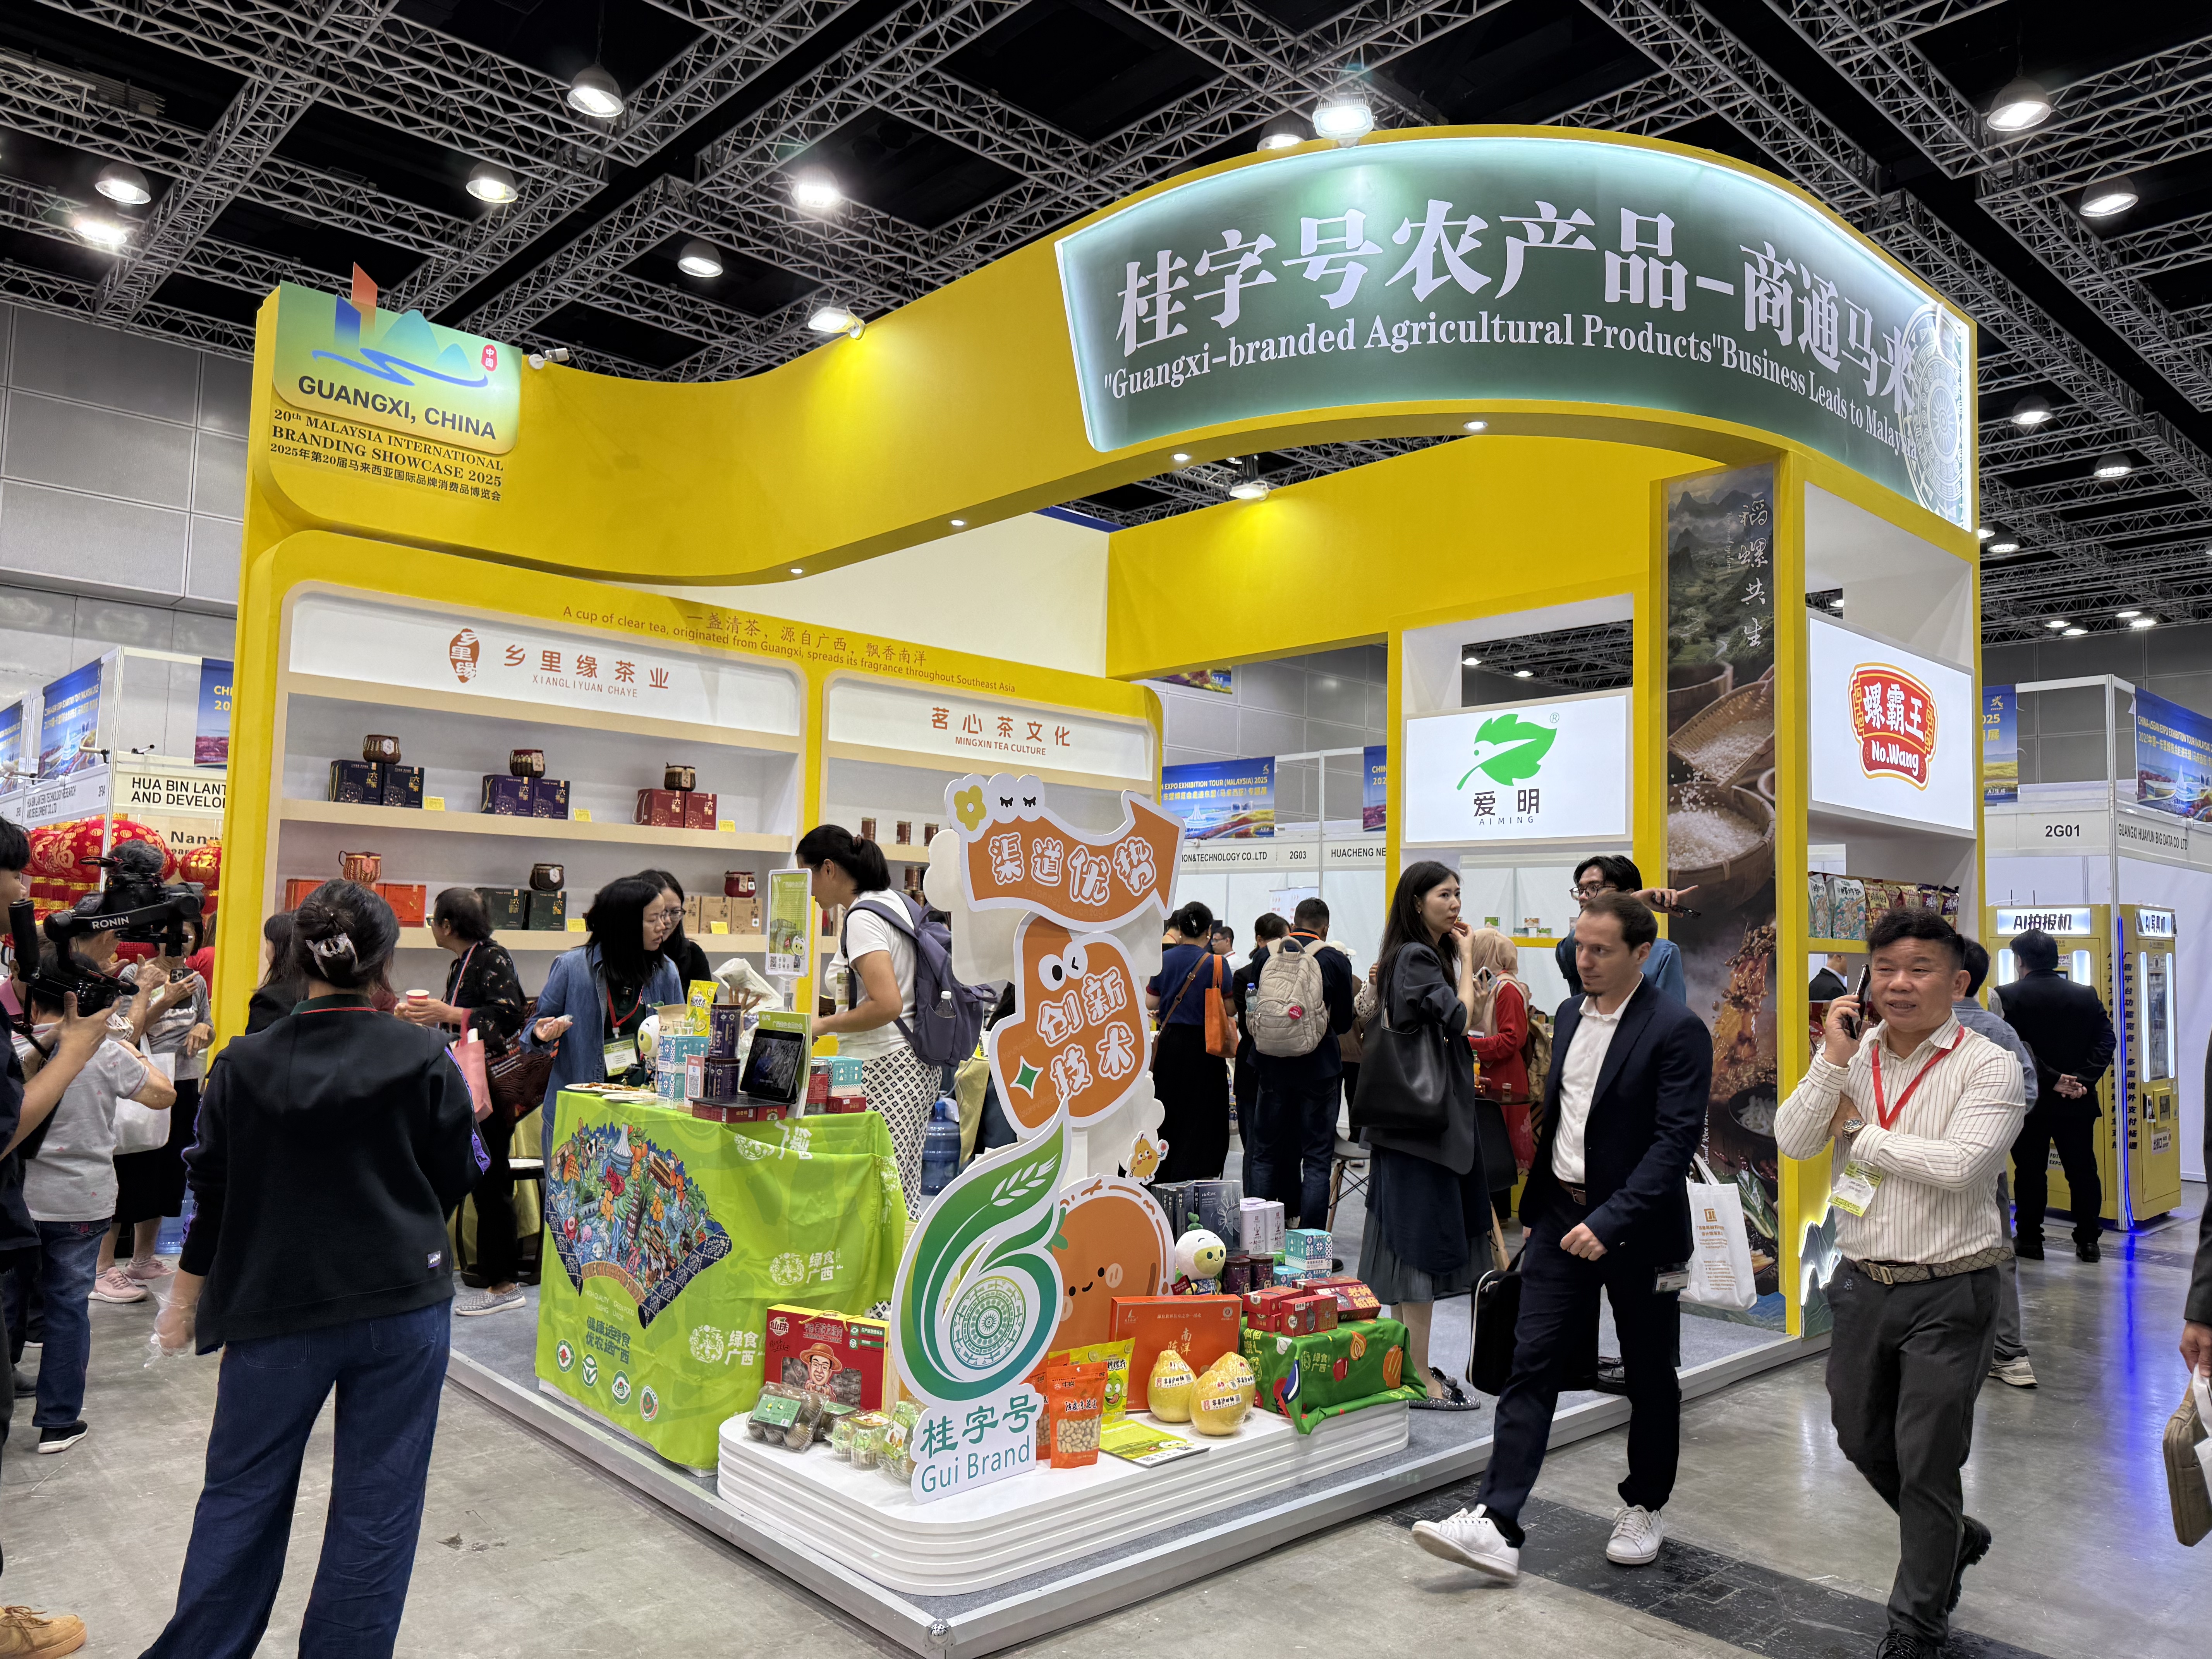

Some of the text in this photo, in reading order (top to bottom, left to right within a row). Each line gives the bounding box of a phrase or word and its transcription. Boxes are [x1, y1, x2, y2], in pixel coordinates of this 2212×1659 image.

[1364, 311, 1573, 353] Agricultural
[1809, 371, 1847, 421] Leads
[1850, 398, 1863, 428] to
[298, 375, 496, 440] GUANGXI, CHINA
[274, 409, 505, 471] 20th MALAYSIA INTERNATIONAL
[272, 425, 502, 488] BRANDING SHOWCASE 2025
[270, 443, 502, 502] 2025年第20届马来西亚国际品牌消费品博览会
[563, 606, 1016, 693] A cup of clear tea, originated from Guangxi, spreads its fragrance throughout Southeast Asia
[503, 644, 669, 690] 乡里缘茶业
[608, 685, 638, 698] CHAYE
[1862, 682, 1925, 743] 螺霸王
[931, 707, 1070, 747] 茗心茶文化
[955, 736, 1047, 756] MINGXIN TEA CULTURE
[1871, 739, 1919, 777] No.Wang
[132, 776, 161, 790] HUA
[167, 780, 189, 793] BIN
[1178, 780, 1208, 789] EXHIBITION
[1224, 776, 1253, 787] (MALAYSIA)
[131, 790, 161, 804] AND
[1474, 788, 1540, 817] 爱明
[1479, 816, 1534, 826] AIMING
[2045, 824, 2081, 838] 2G01
[2118, 823, 2138, 839] GUANGXI
[2138, 828, 2155, 843] HUAYUN
[2163, 833, 2173, 847] DATA
[1289, 850, 1307, 860] 2G03
[1331, 847, 1374, 858] HUACHENG
[989, 833, 1157, 907] 渠道优势
[91, 915, 129, 929] RONIN
[1037, 965, 1127, 1048] 创新
[1050, 1021, 1135, 1099] 技术
[808, 1250, 835, 1268] 绿食
[805, 1265, 834, 1284] 广西
[594, 1293, 610, 1304] QUALITY
[769, 1319, 789, 1333] 仙珠
[729, 1331, 759, 1348] 绿食
[724, 1346, 754, 1366] 广西
[920, 1394, 1037, 1459] 桂字号
[921, 1435, 1030, 1493] Gui Brand
